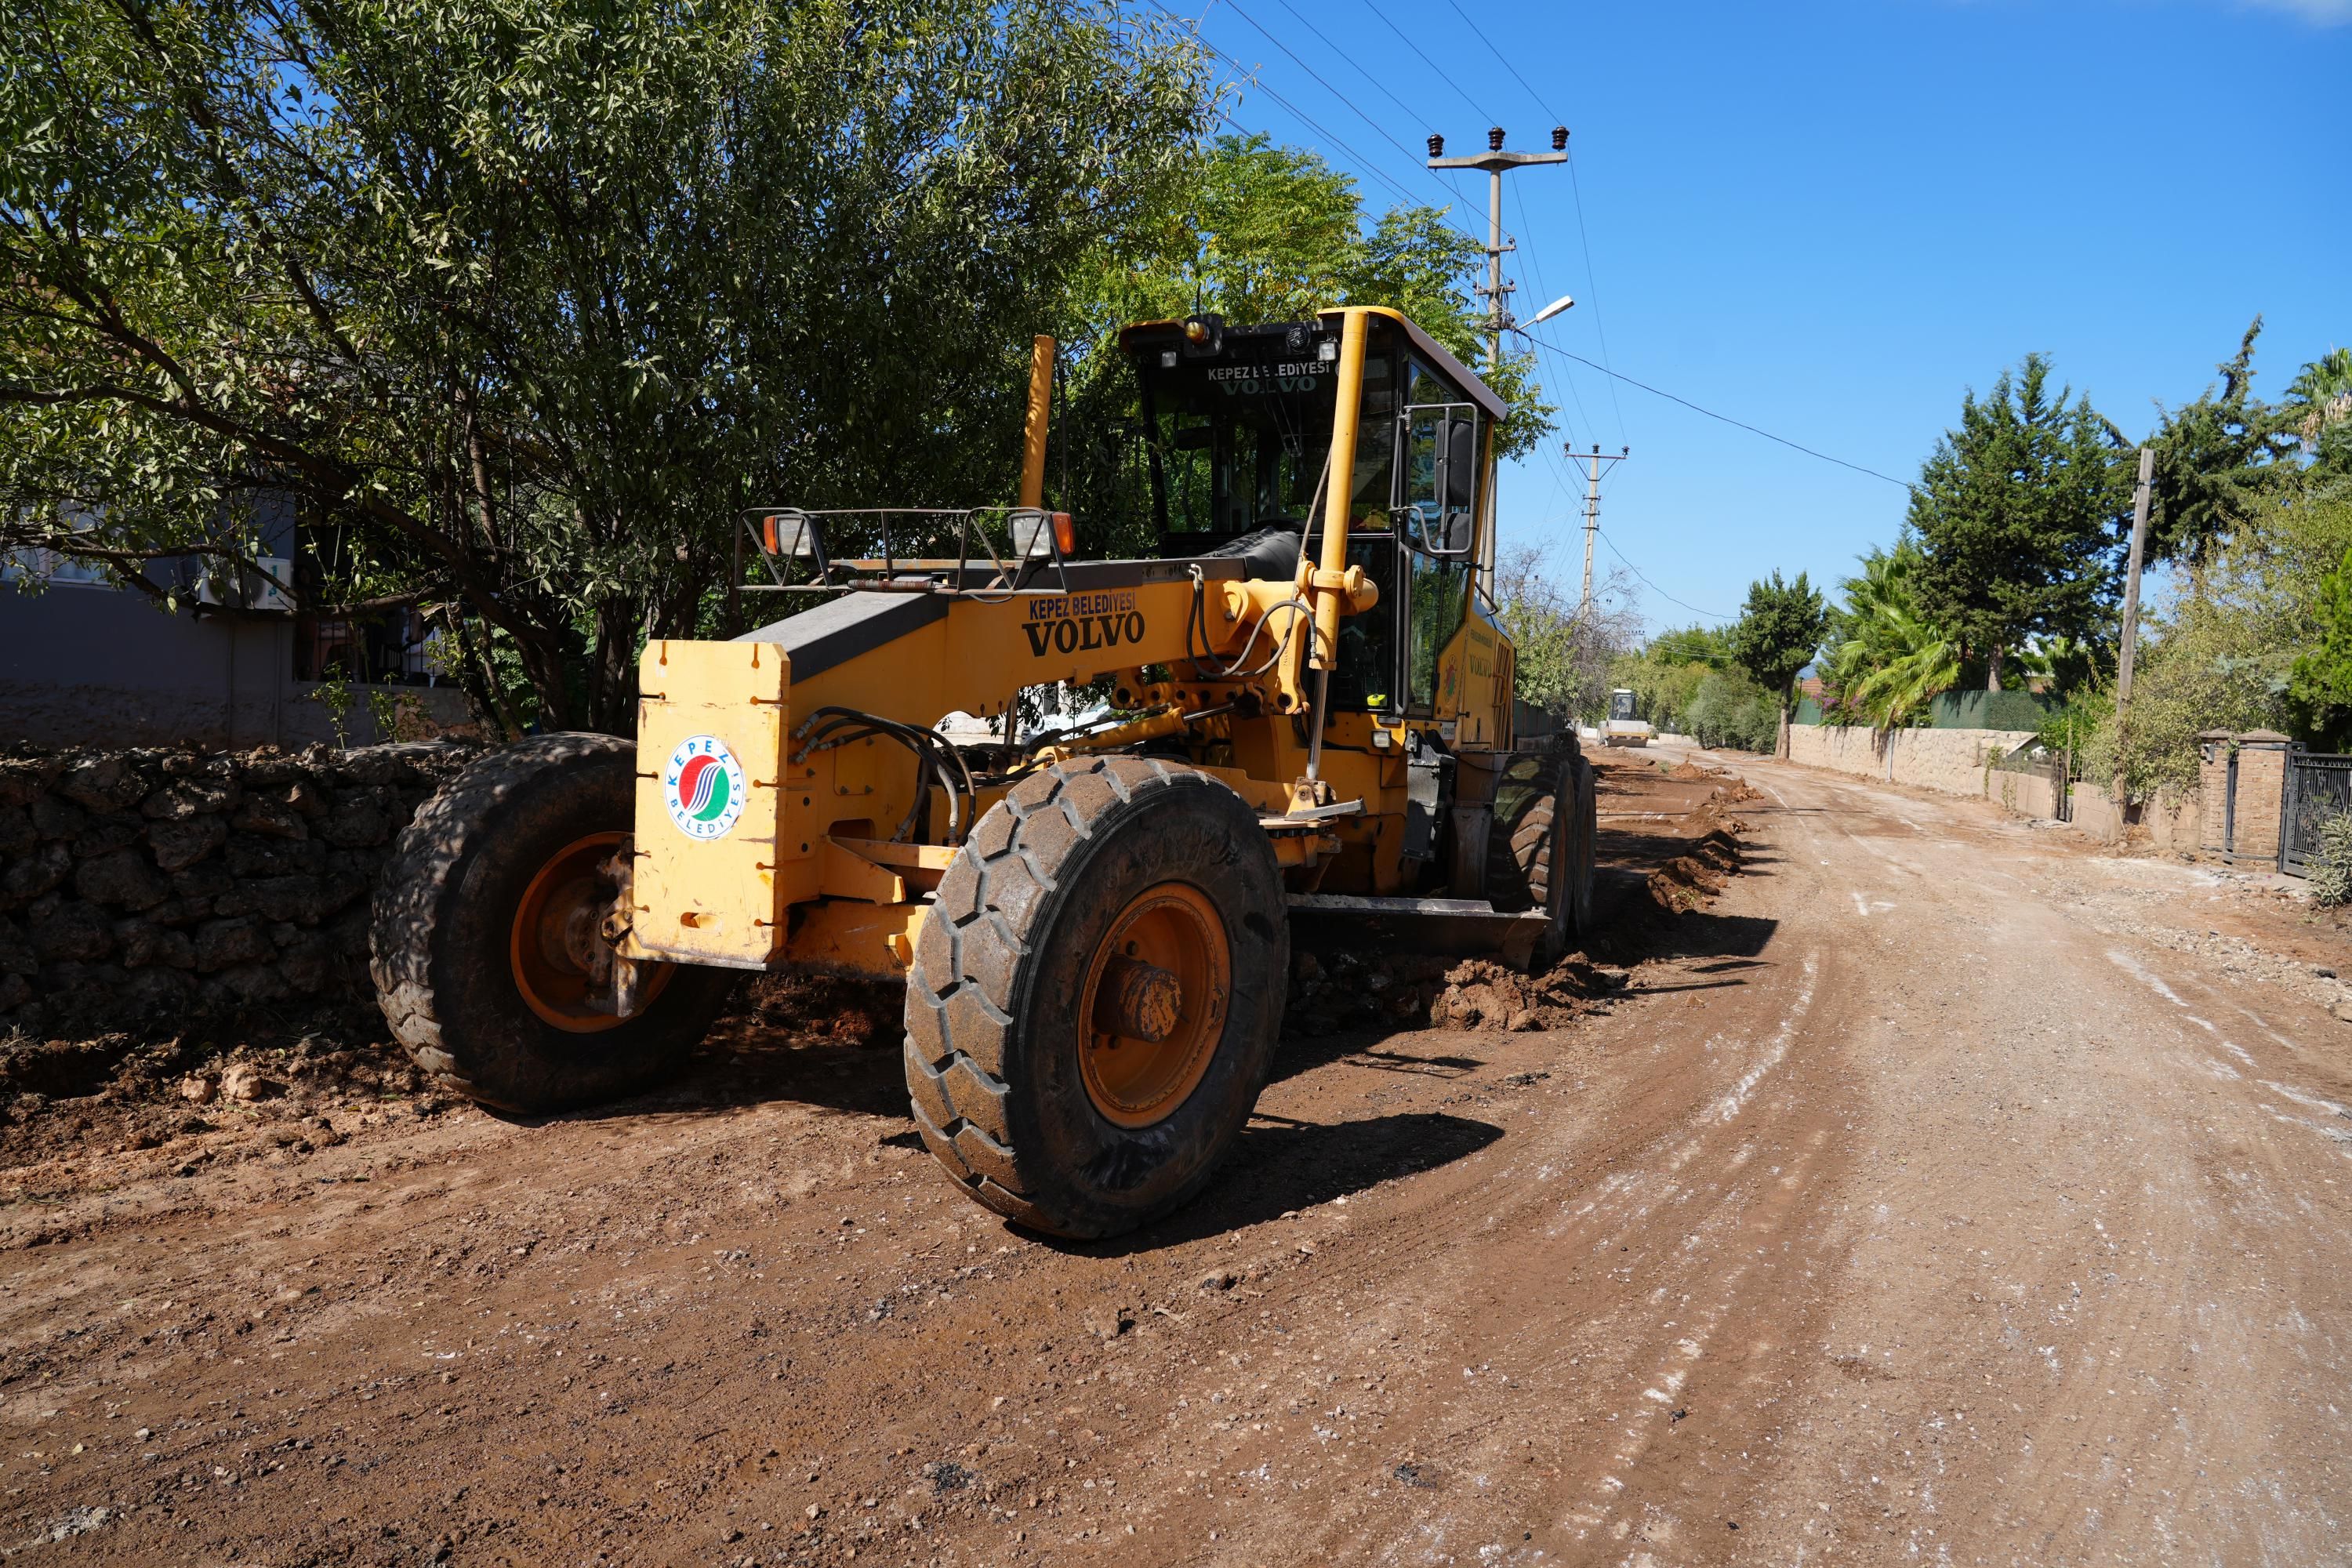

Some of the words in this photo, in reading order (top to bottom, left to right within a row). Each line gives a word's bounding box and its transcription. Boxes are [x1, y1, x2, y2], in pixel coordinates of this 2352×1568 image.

[1208, 366, 1249, 380] KEPEZ
[1253, 361, 1330, 378] EEDİYESİ
[1029, 597, 1069, 620] KEPEZ
[1073, 589, 1136, 615] BELEDİYESİ
[1022, 611, 1145, 657] VOLVO
[1469, 652, 1492, 678] VOLVO
[668, 740, 728, 786] KEPEZ
[670, 772, 741, 833] BELEDİYESİ
